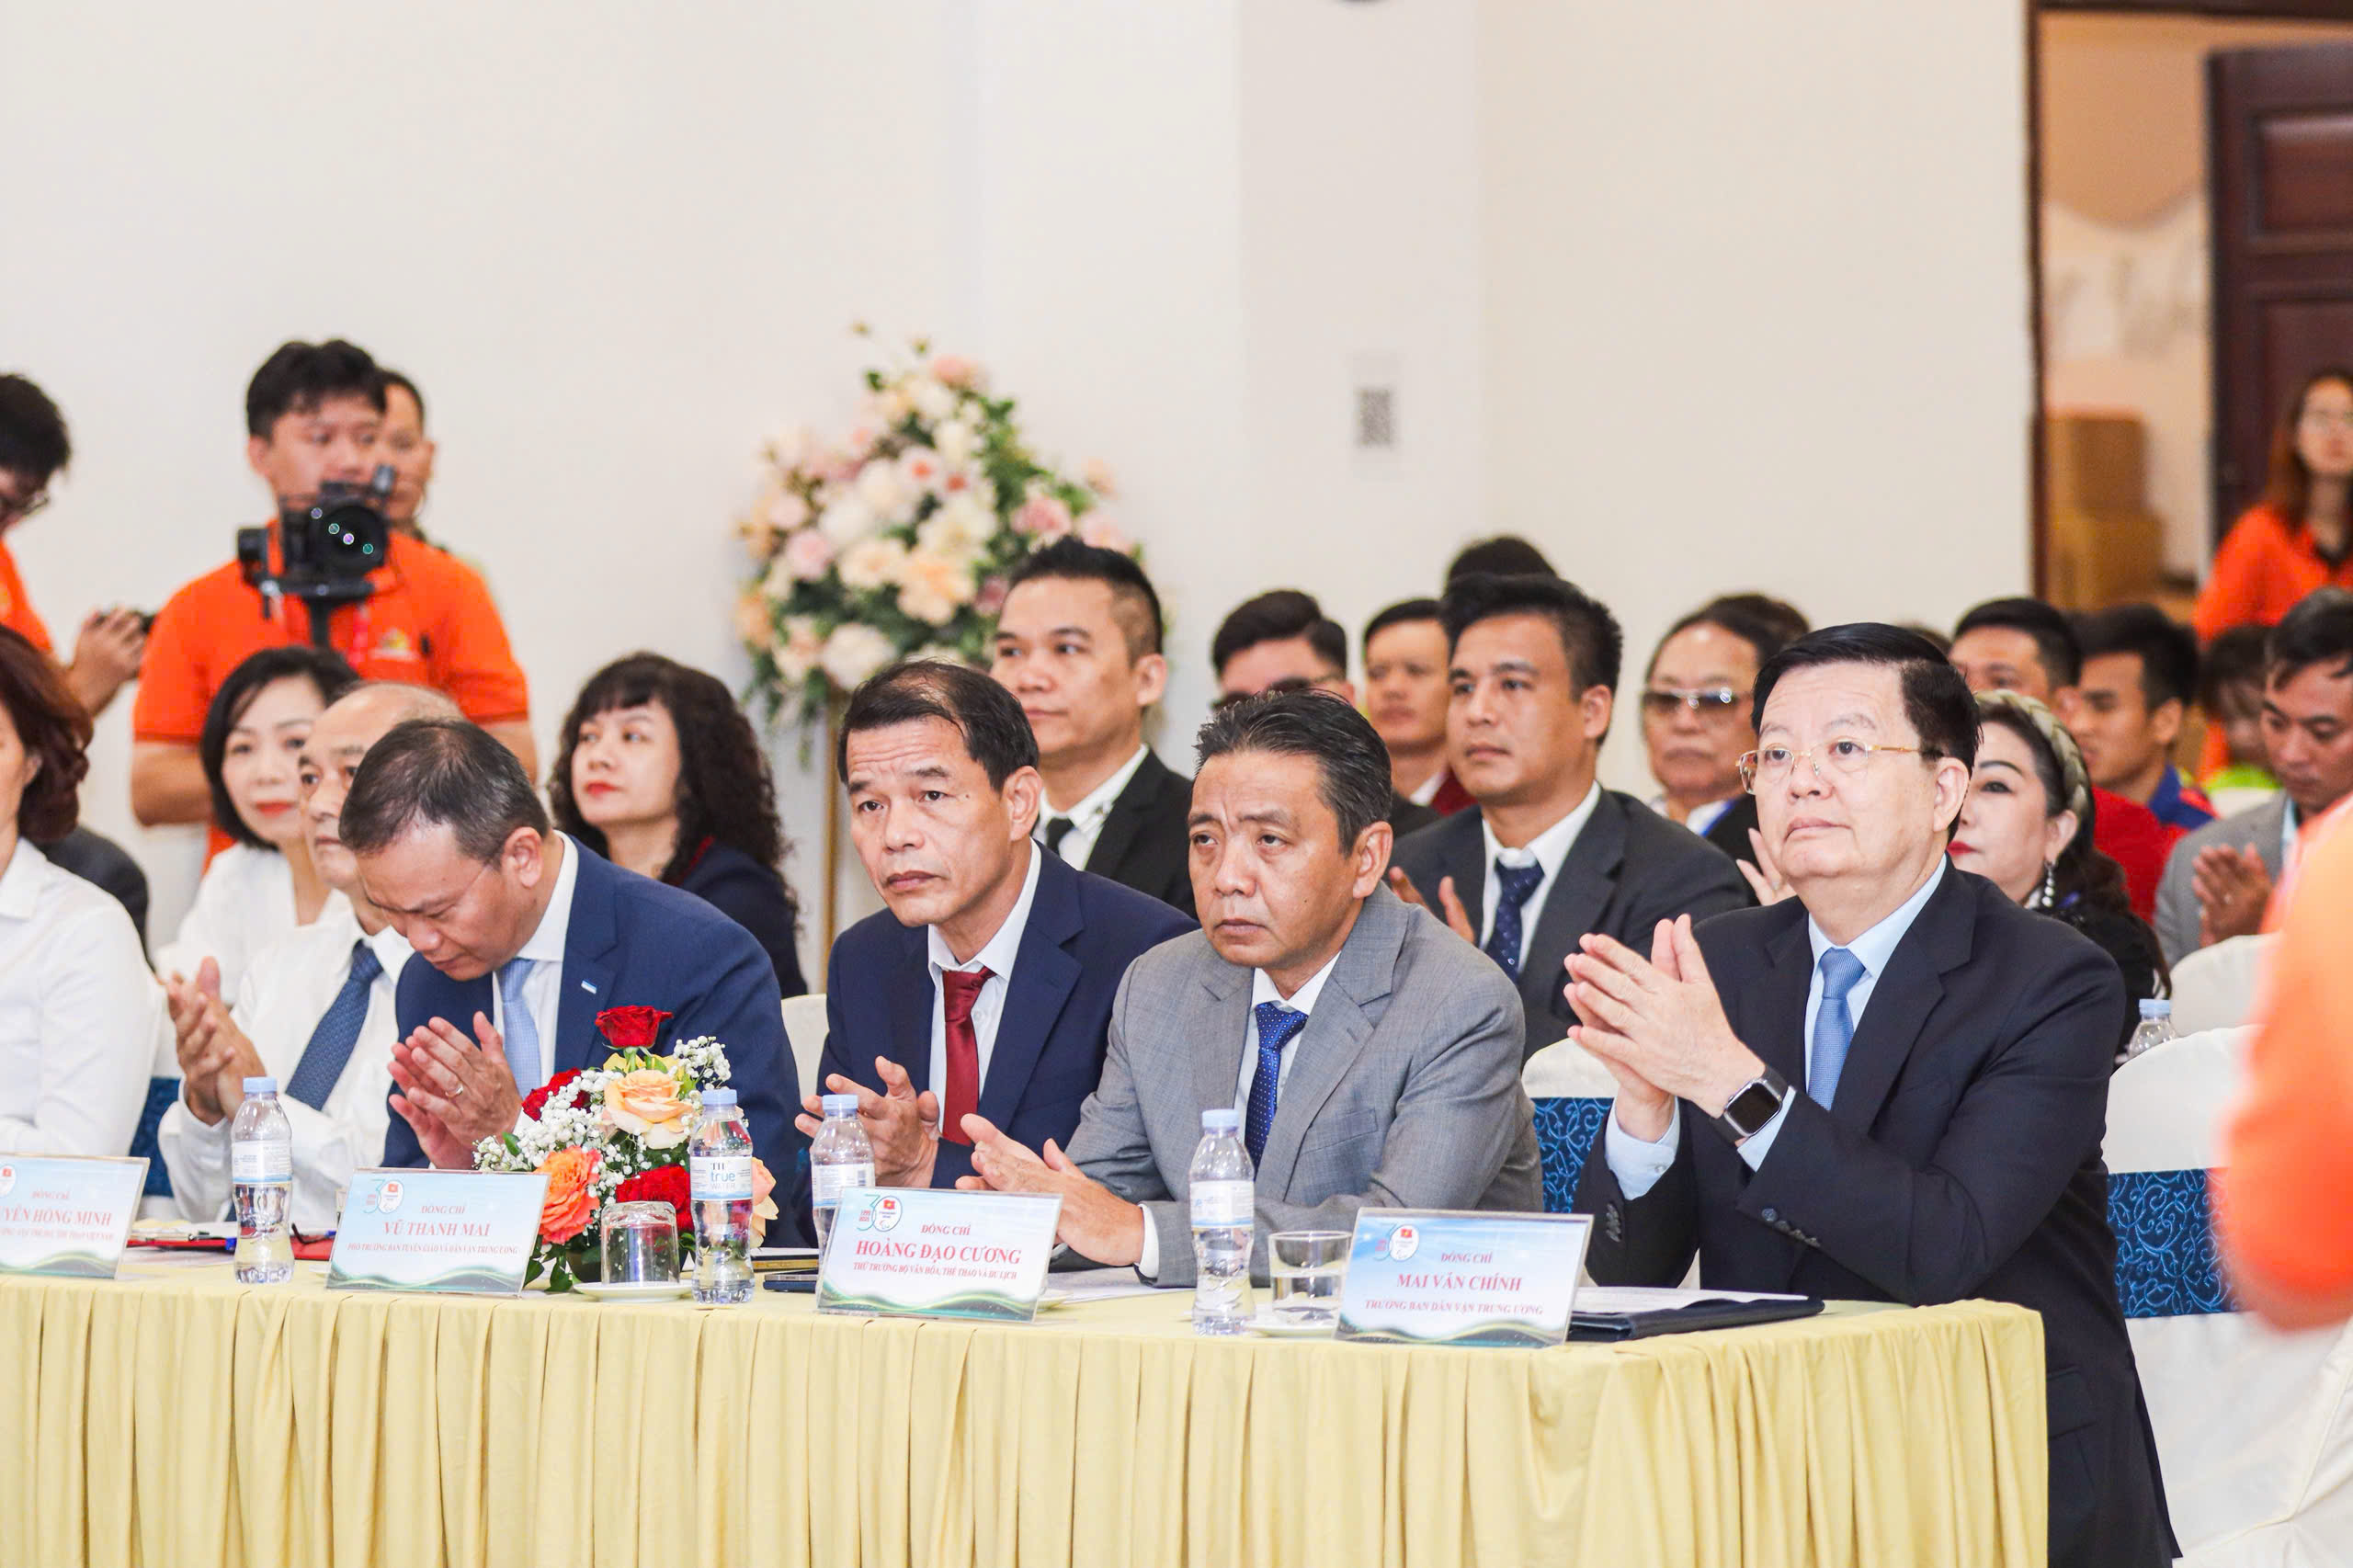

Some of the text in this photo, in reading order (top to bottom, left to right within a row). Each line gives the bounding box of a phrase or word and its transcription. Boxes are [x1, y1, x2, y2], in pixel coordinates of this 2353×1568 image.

[710, 1171, 736, 1182] true
[74, 1210, 112, 1227] MINH
[383, 1219, 404, 1236] VŨ
[460, 1221, 492, 1236] MAI
[920, 1222, 972, 1236] ĐỒNG CHÍ
[855, 1237, 1022, 1265] HOÀNG ĐẠO CƯƠNG
[1472, 1250, 1494, 1264] CHÍ
[1396, 1271, 1522, 1291] MAI VĂN CHÍNH
[1409, 1301, 1430, 1311] BAN
